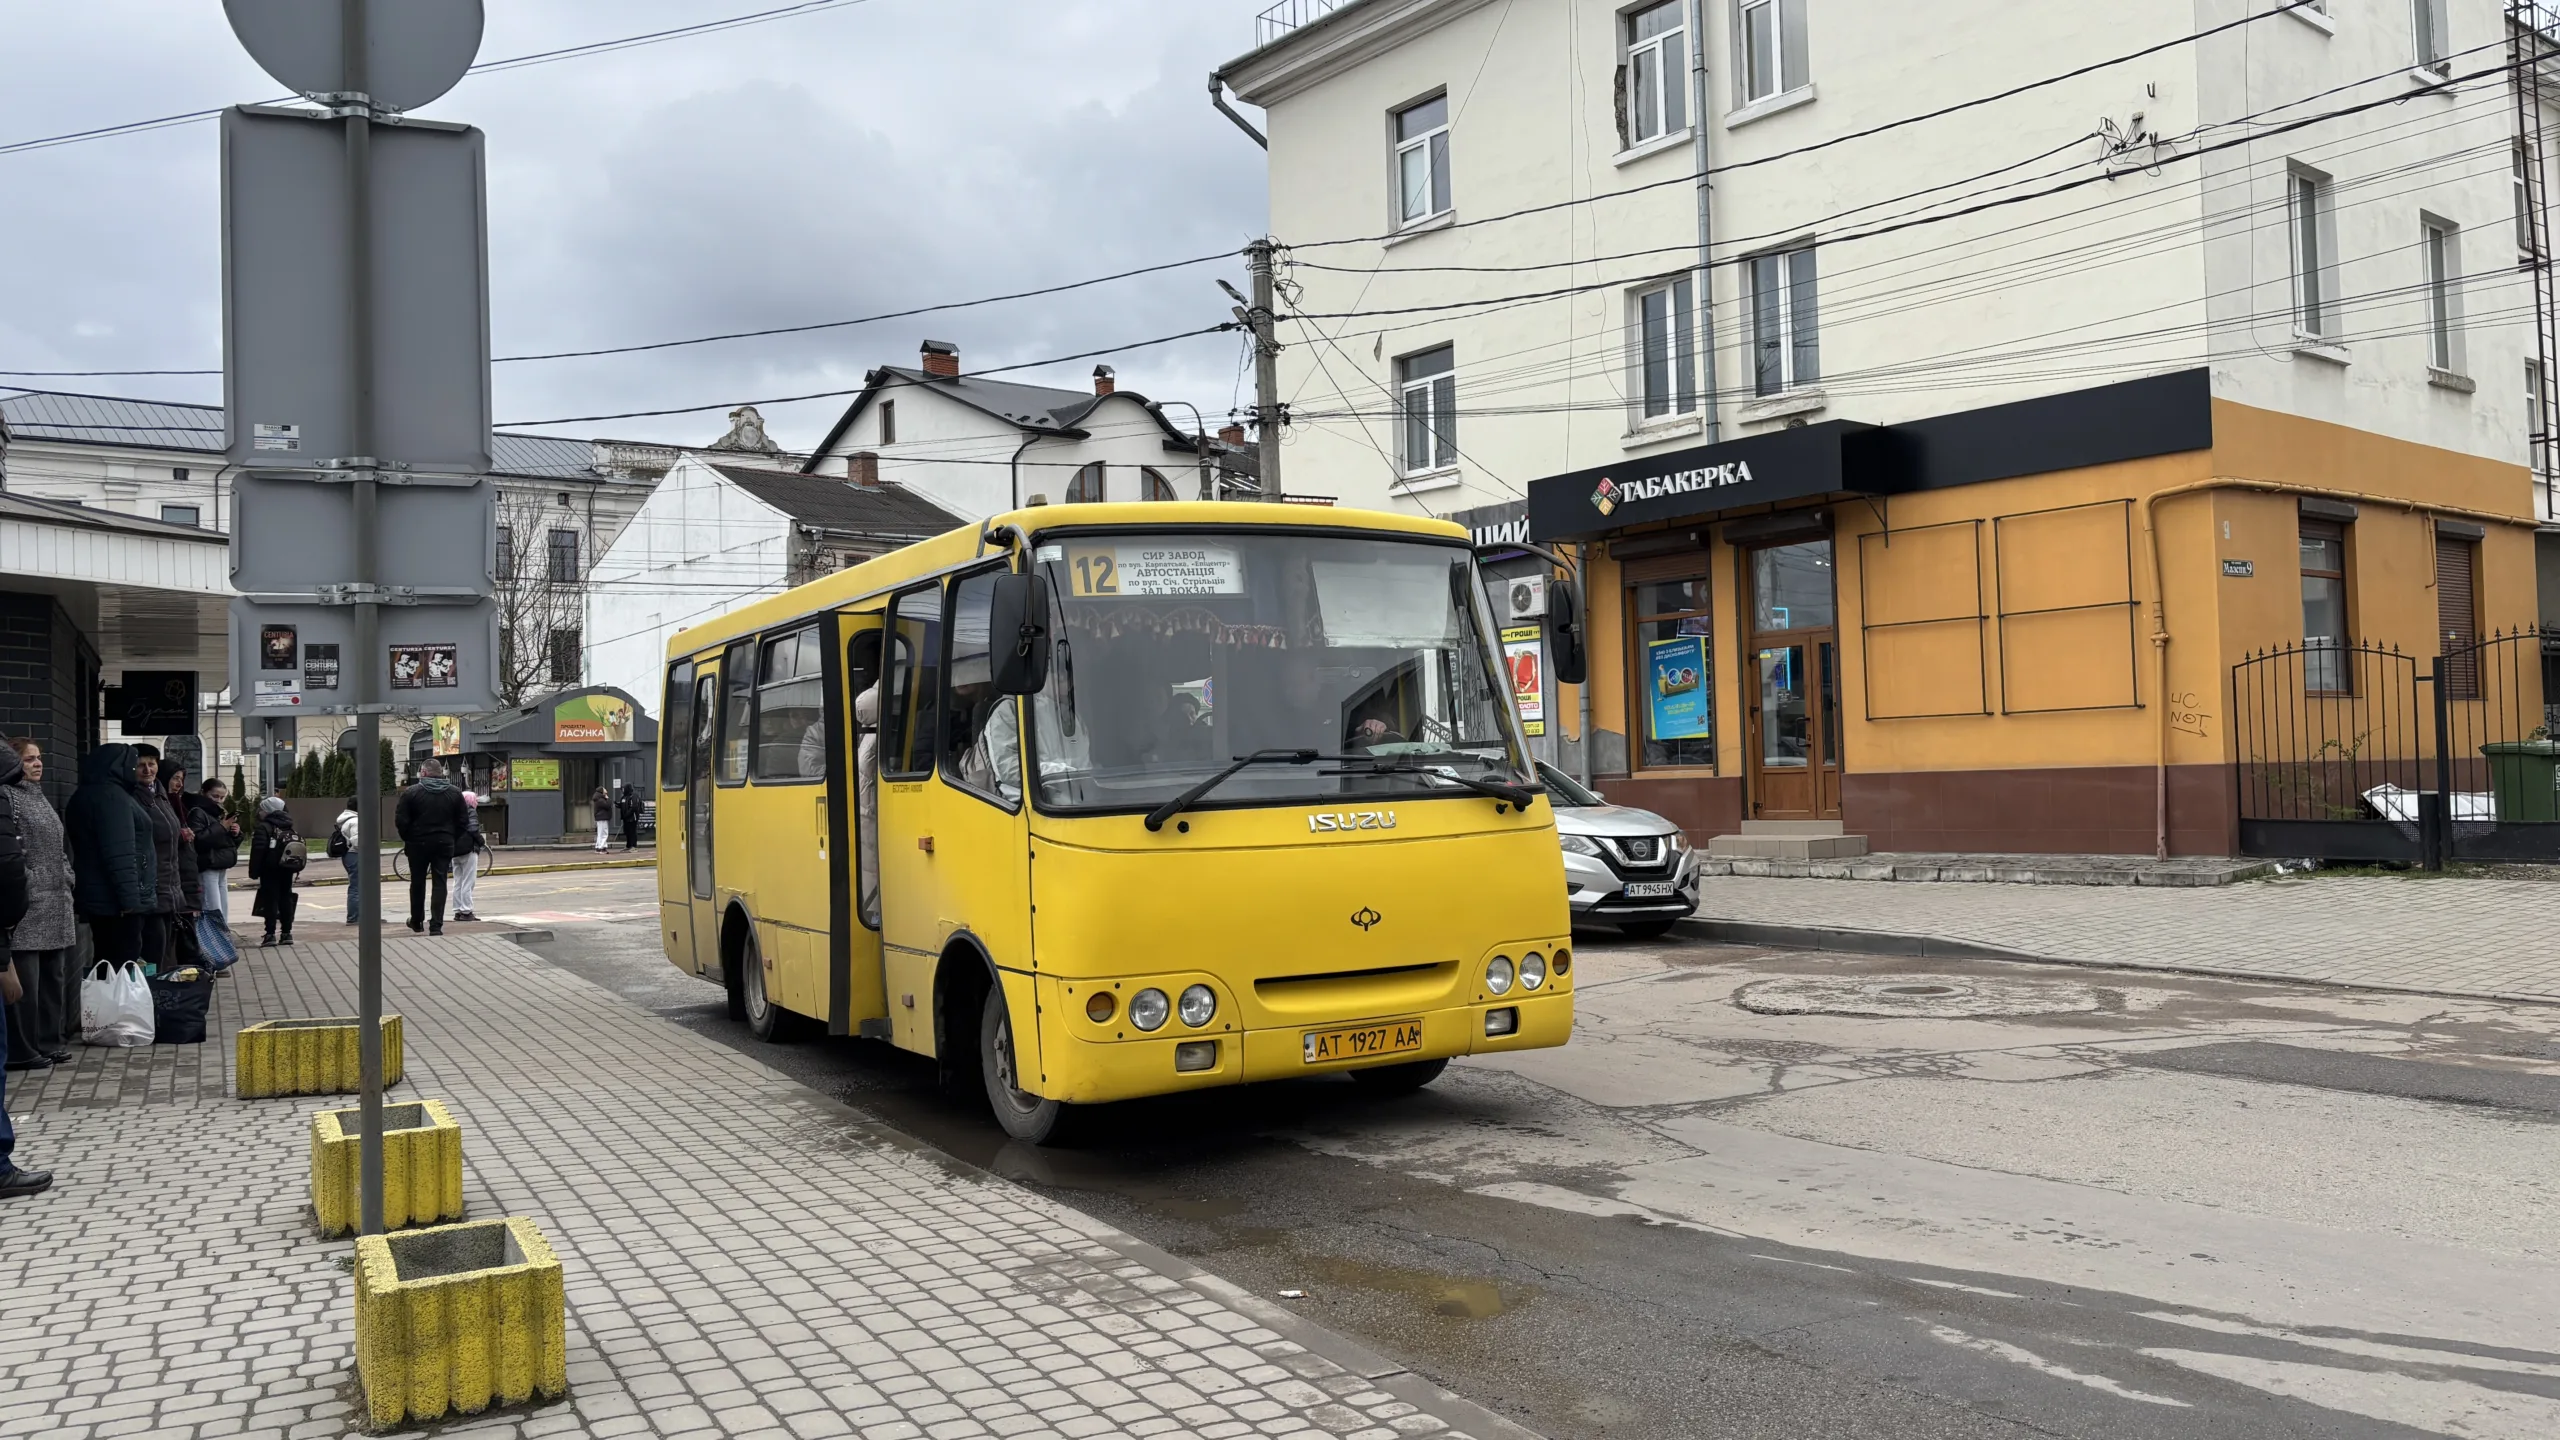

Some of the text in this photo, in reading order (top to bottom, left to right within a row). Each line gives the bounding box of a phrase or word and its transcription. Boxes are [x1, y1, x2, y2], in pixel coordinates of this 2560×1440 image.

[1619, 460, 1753, 503] ТАБАКЕРКА
[1142, 551, 1206, 561] СИР ЗАВОД
[1136, 567, 1215, 578] АВТОСТАНЦІЯ
[2246, 562, 2253, 574] 9
[1076, 555, 1117, 593] 12
[1128, 577, 1225, 589] по вул. Січ. Стрільців
[1172, 586, 1215, 595] ВОКЗАЛ
[263, 631, 294, 639] CENTURIA
[1511, 629, 1533, 638] ГРОШІ
[559, 729, 604, 738] ЛАСУНКА
[1308, 810, 1397, 833] ISUZU
[1630, 884, 1672, 895] AT 9945 HX
[1317, 1025, 1418, 1057] AT 1927 AA
